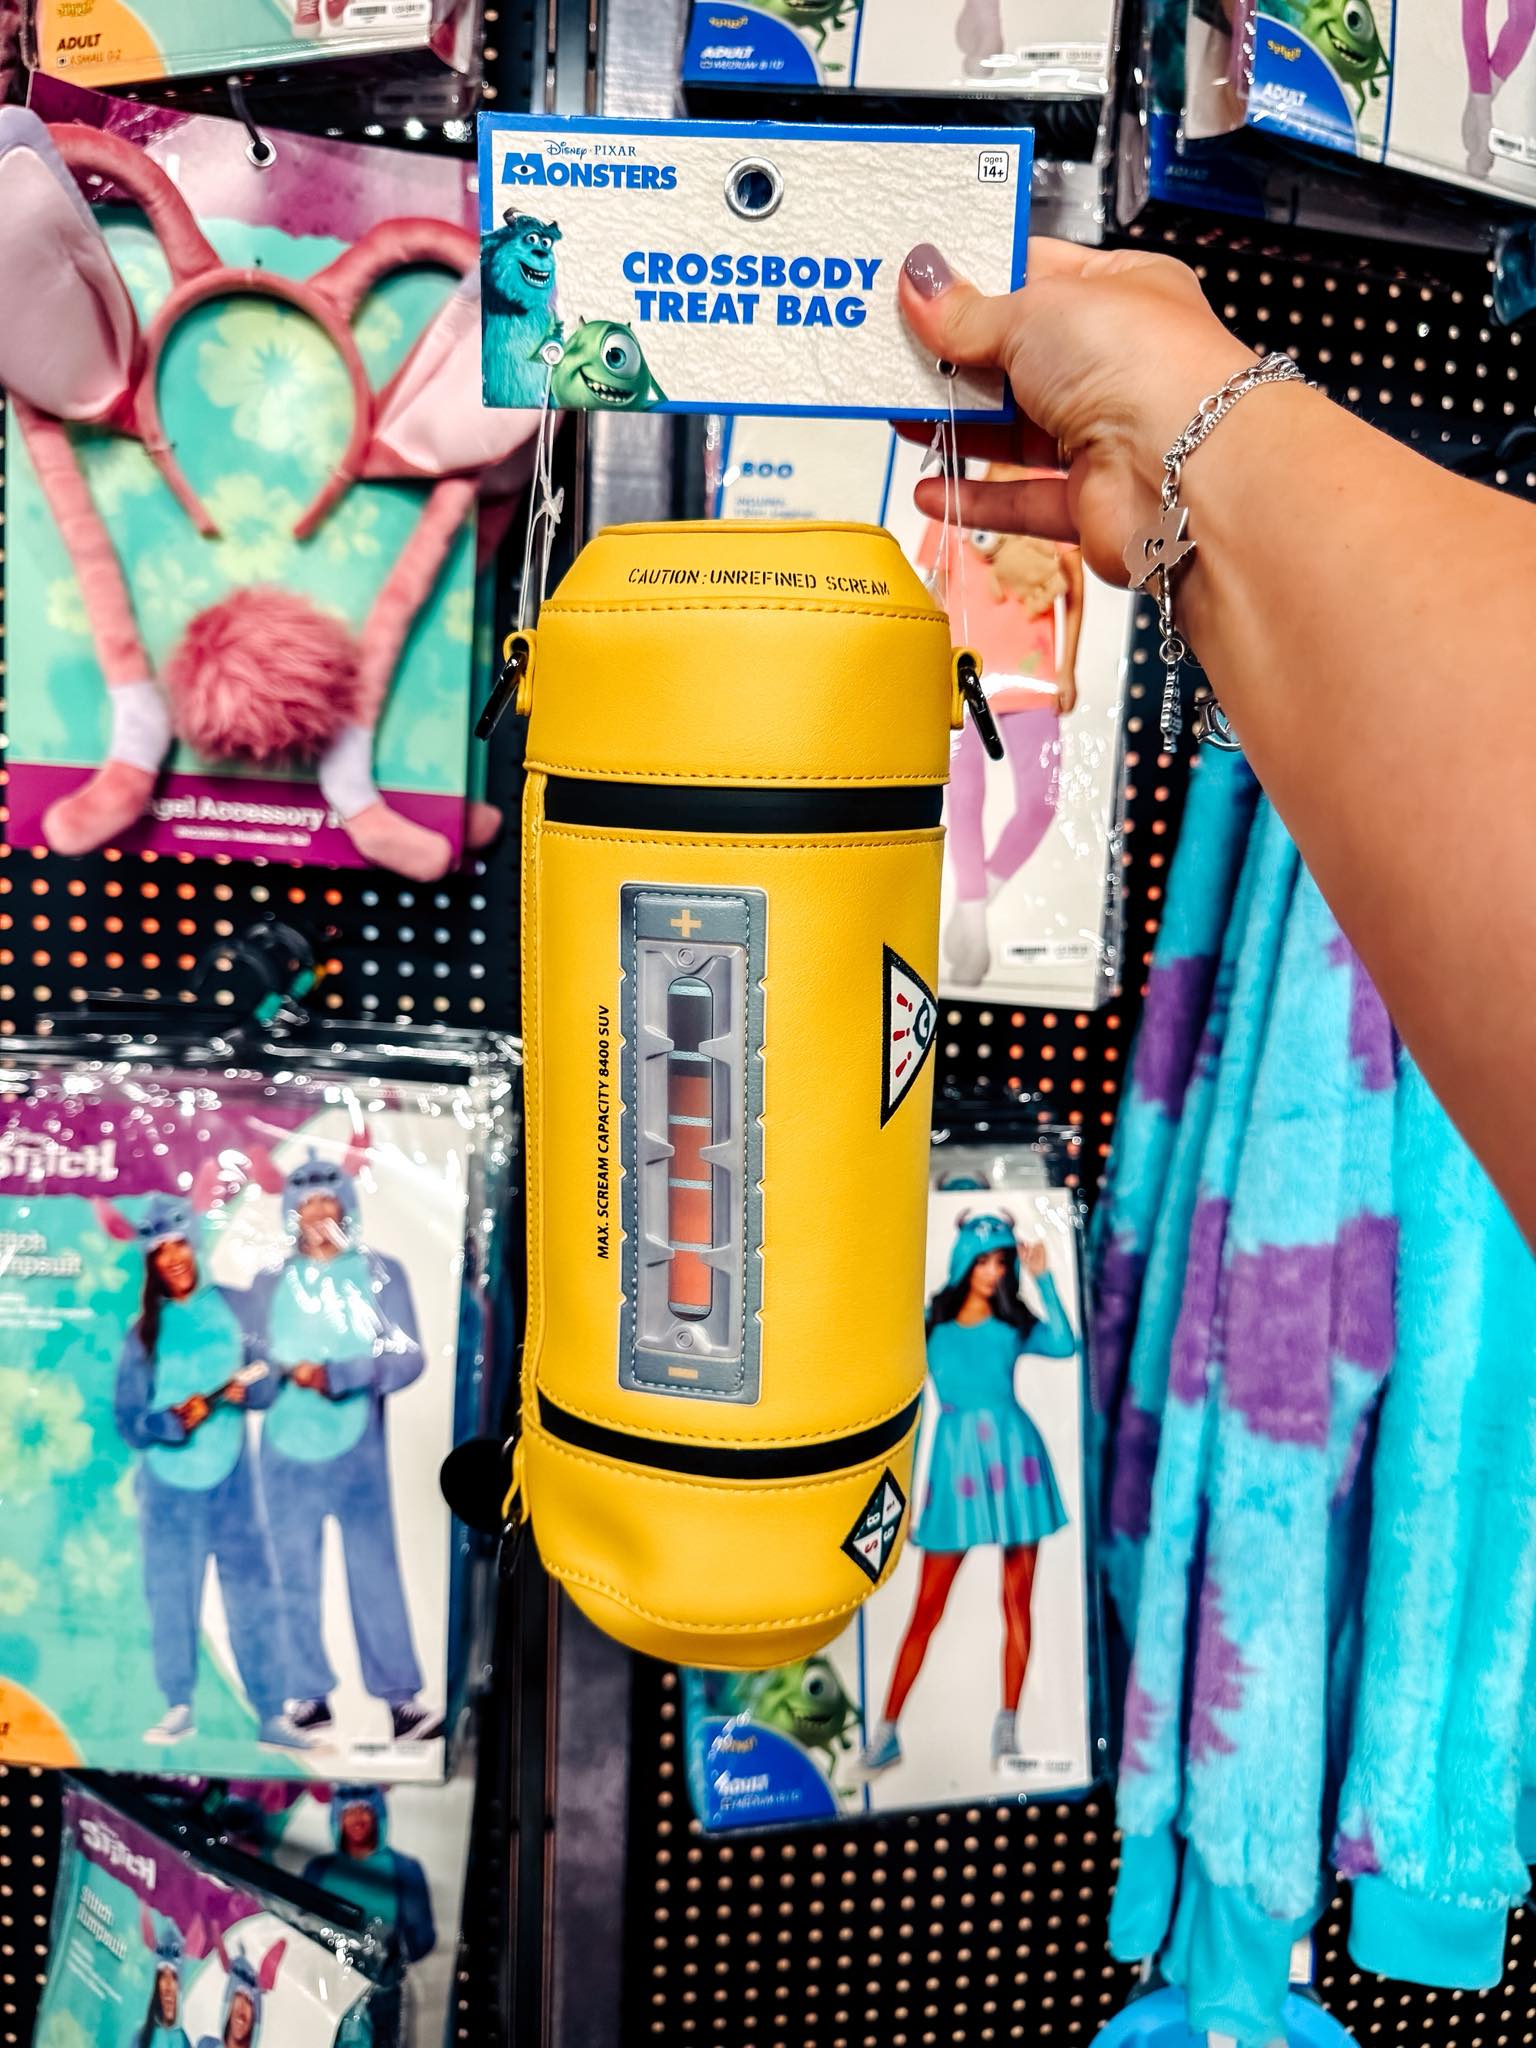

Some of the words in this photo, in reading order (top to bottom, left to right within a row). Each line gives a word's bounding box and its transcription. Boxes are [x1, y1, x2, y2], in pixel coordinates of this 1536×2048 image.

[57, 33, 101, 51] ADULT
[594, 145, 637, 157] PIXAR
[984, 156, 1003, 165] ages
[501, 152, 677, 190] MONSTERS
[983, 165, 1004, 178] 14+
[622, 251, 883, 290] CROSSBODY
[634, 290, 760, 325] TREAT
[777, 294, 867, 328] BAG
[825, 575, 890, 596] SCREAM
[197, 796, 326, 832] Accessory
[598, 1005, 609, 1037] SUV
[598, 1040, 609, 1077] 8400
[598, 1080, 609, 1154] CAPACITY
[597, 1157, 609, 1218] SCREAM
[597, 1222, 609, 1259] MAX.
